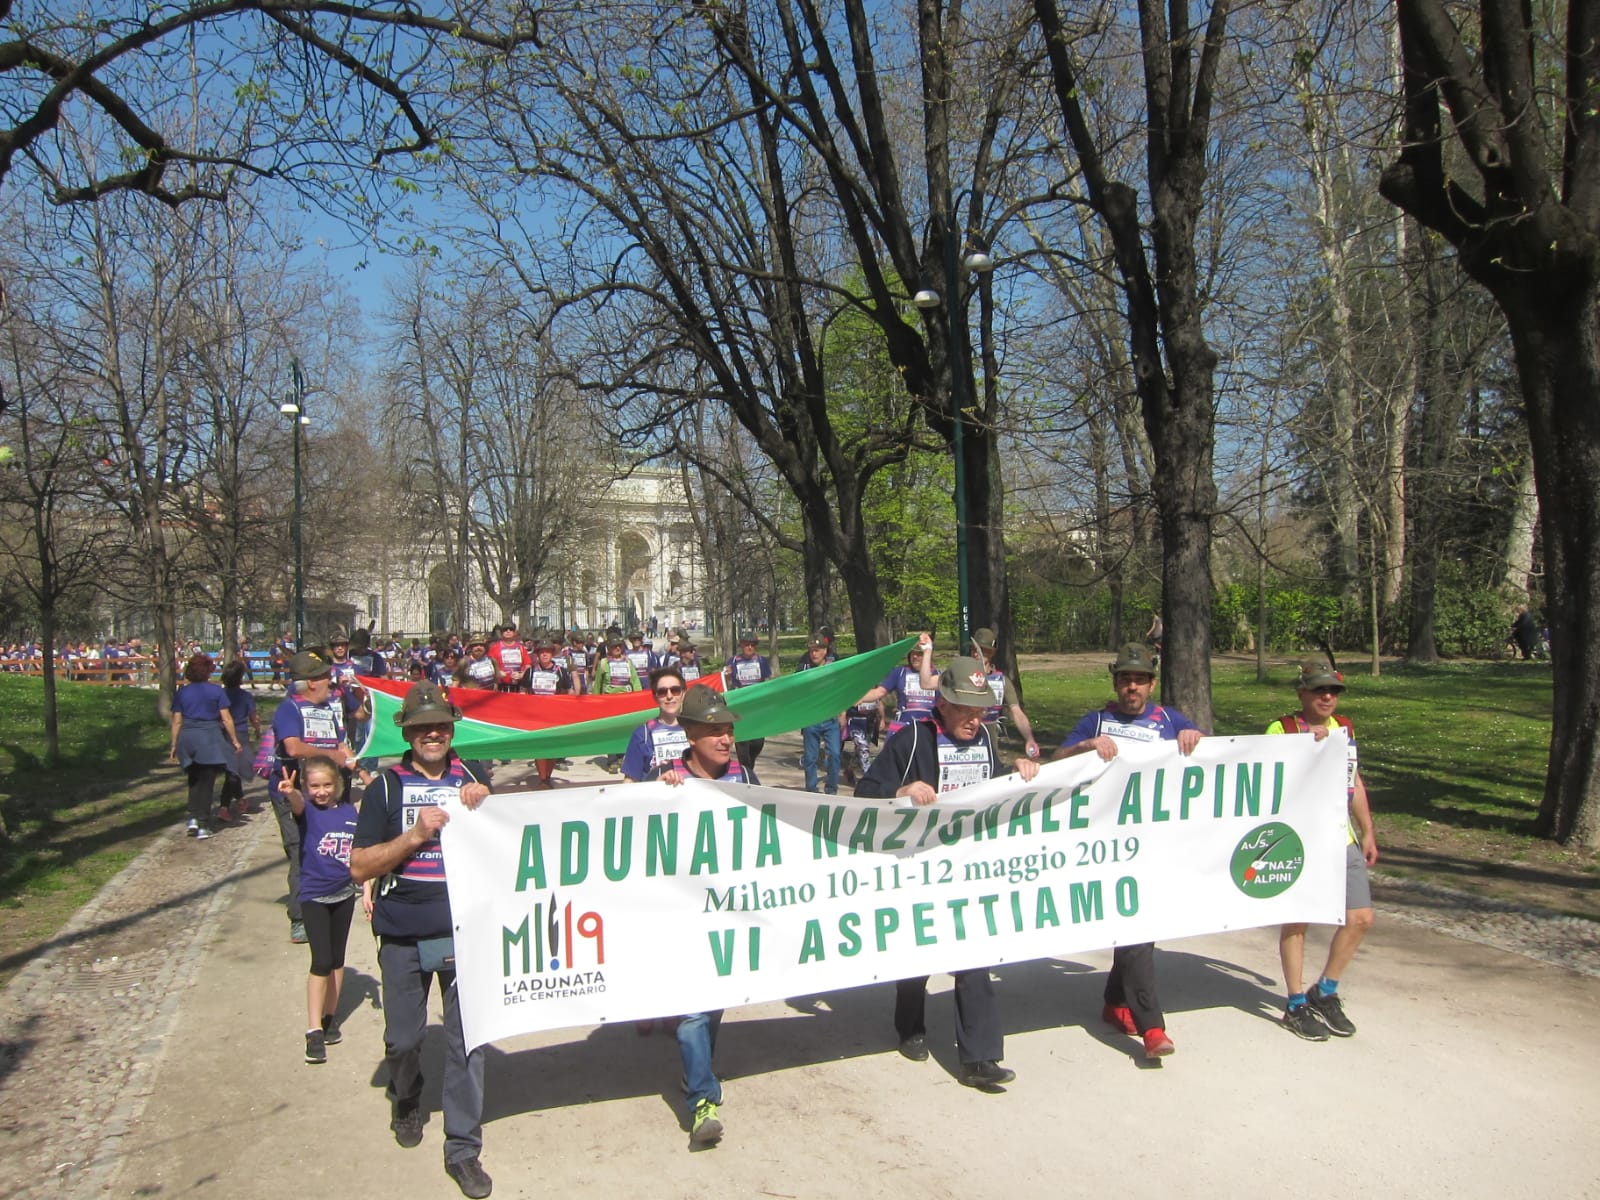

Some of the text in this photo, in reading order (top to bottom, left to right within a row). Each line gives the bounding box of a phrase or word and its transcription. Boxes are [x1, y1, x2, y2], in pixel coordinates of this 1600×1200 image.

[1107, 726, 1137, 737] BANCO
[943, 752, 985, 762] BANCO BPM
[514, 762, 1284, 892] ADUNATA NAZIONALE ALPINI
[703, 836, 1140, 914] Milano 10-11-12 maggio 2019
[1254, 872, 1292, 884] ALPINI
[709, 876, 1139, 977] VI ASPETTIAMO
[503, 970, 606, 996] L'ADUNATA
[503, 984, 607, 1006] DEL CENTENARIO
